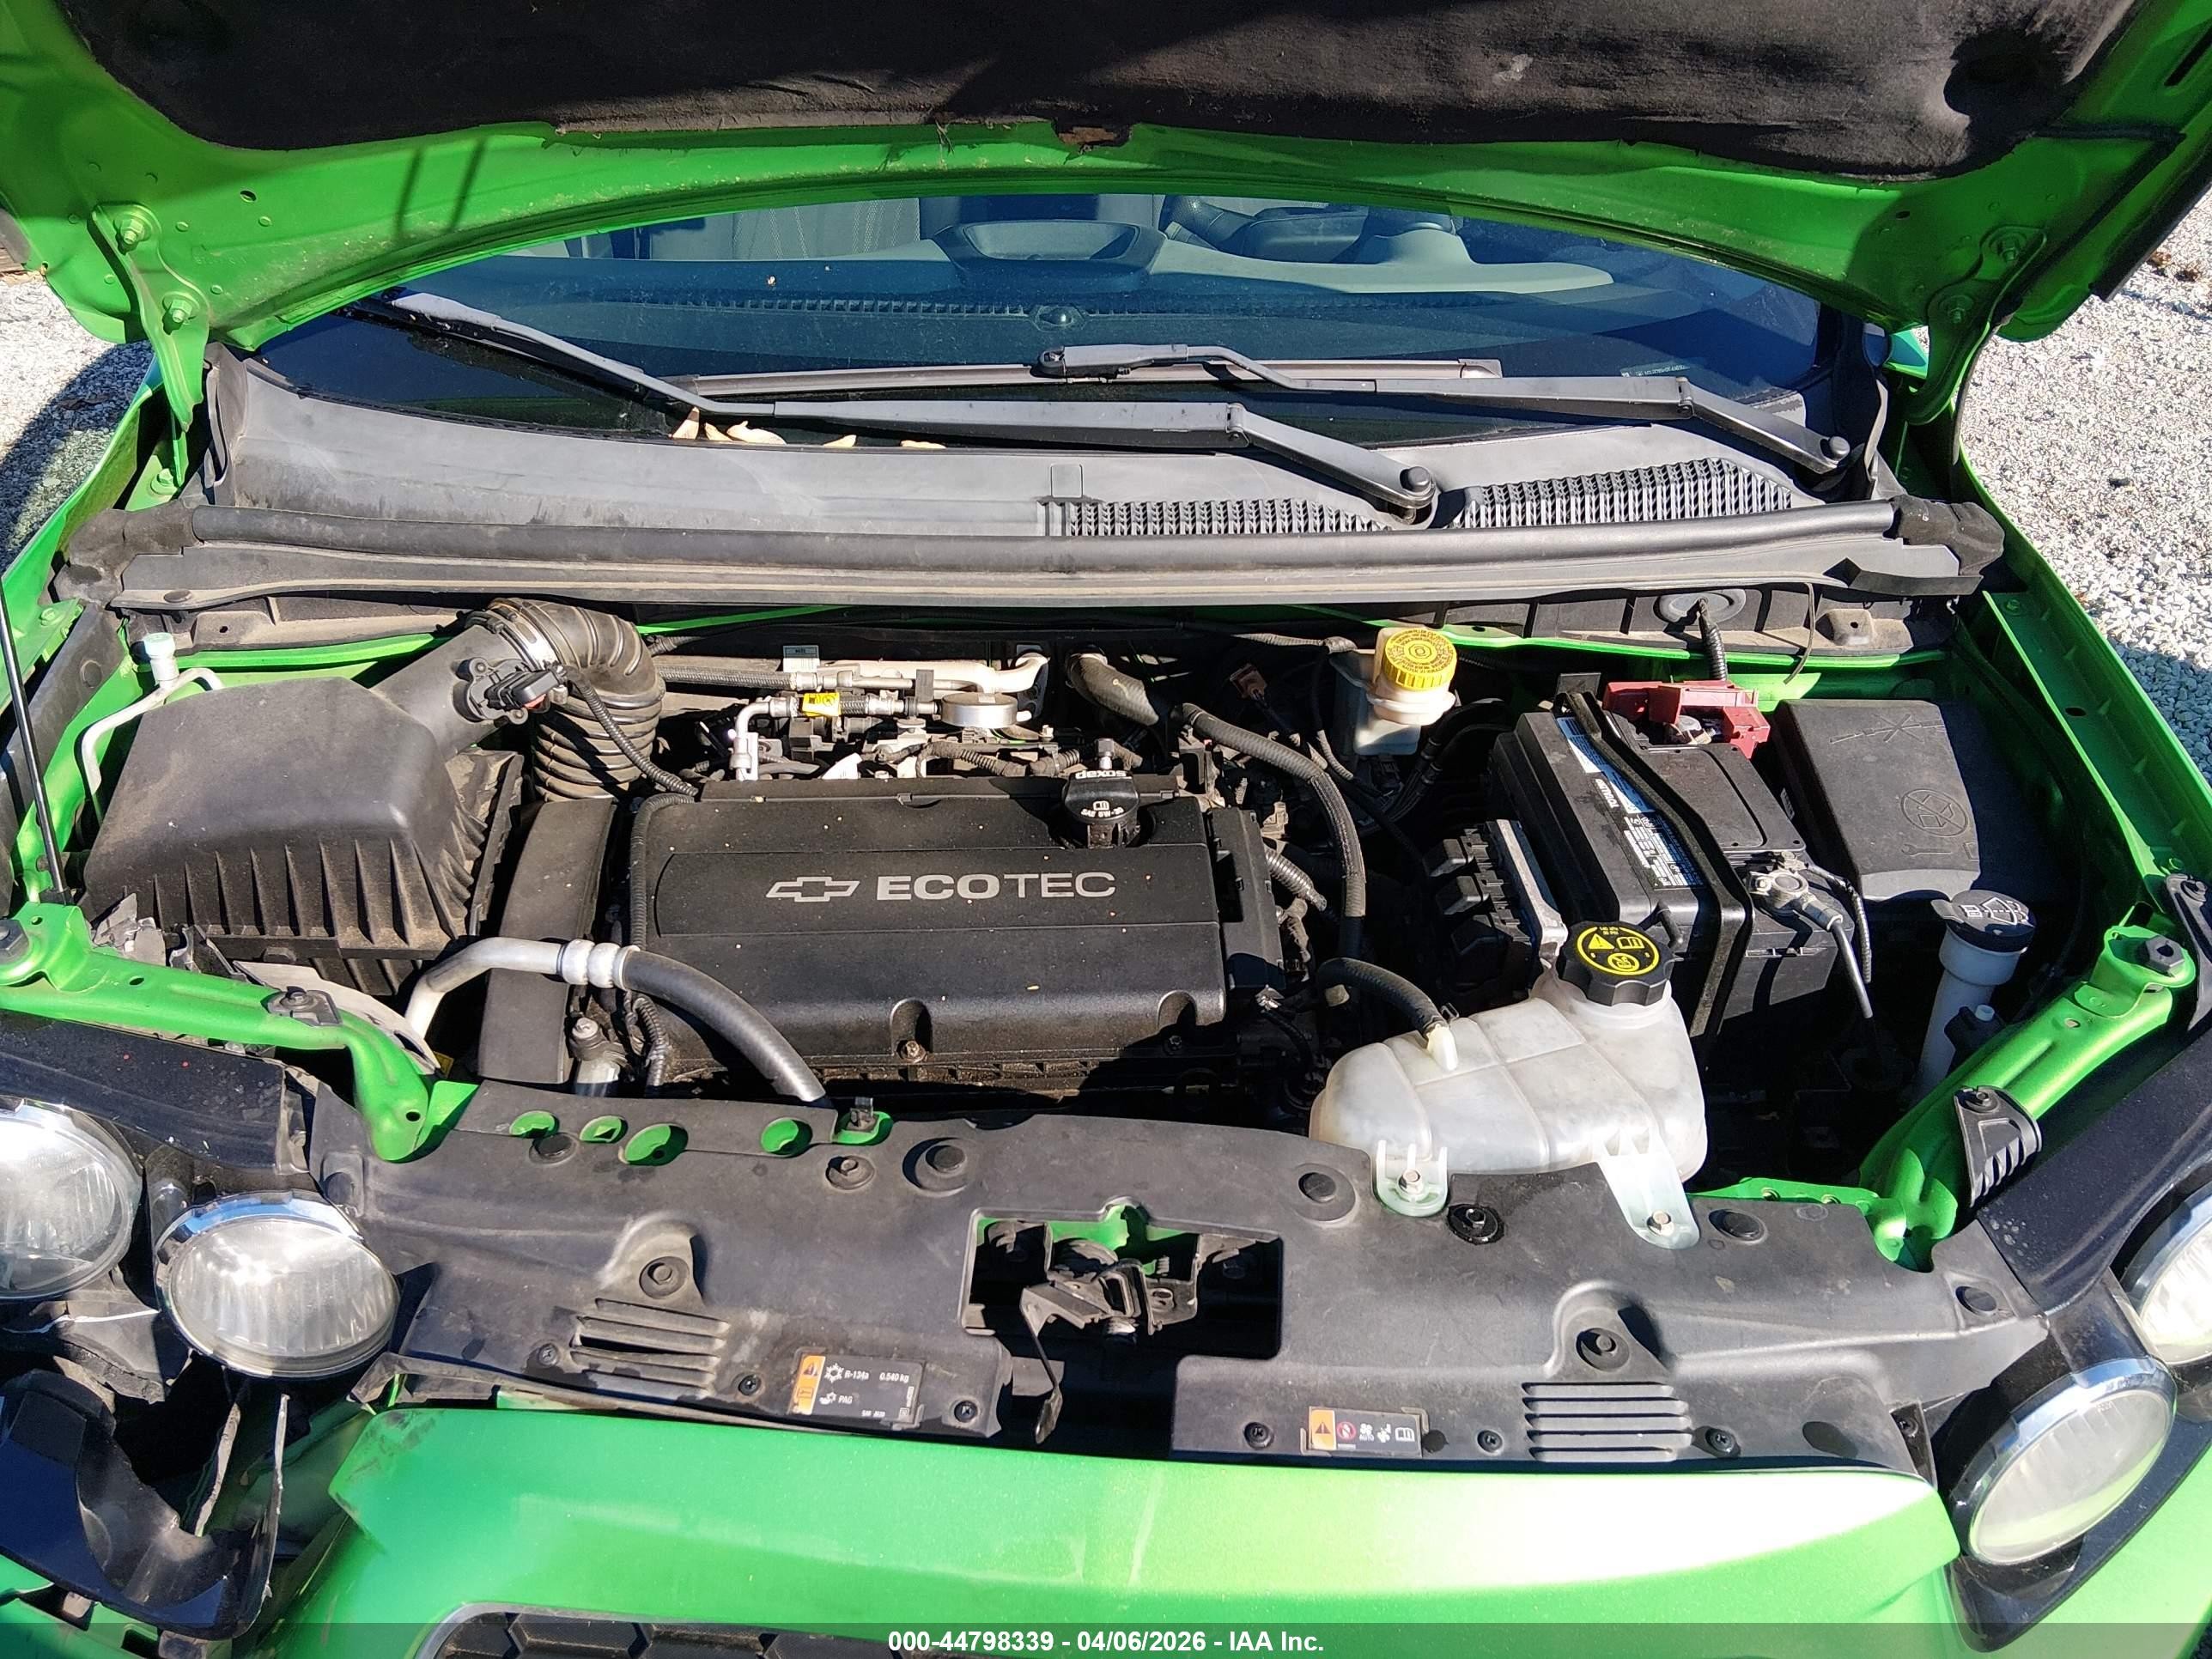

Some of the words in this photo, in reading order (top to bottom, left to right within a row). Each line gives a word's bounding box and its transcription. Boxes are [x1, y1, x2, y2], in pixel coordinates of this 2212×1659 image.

[1075, 770, 1127, 780] dexos
[1080, 808, 1097, 817] SAE
[876, 872, 1116, 901] ECOTEC
[844, 1370, 869, 1381] R-134a
[899, 1373, 909, 1383] kg
[838, 1395, 853, 1404] PAG
